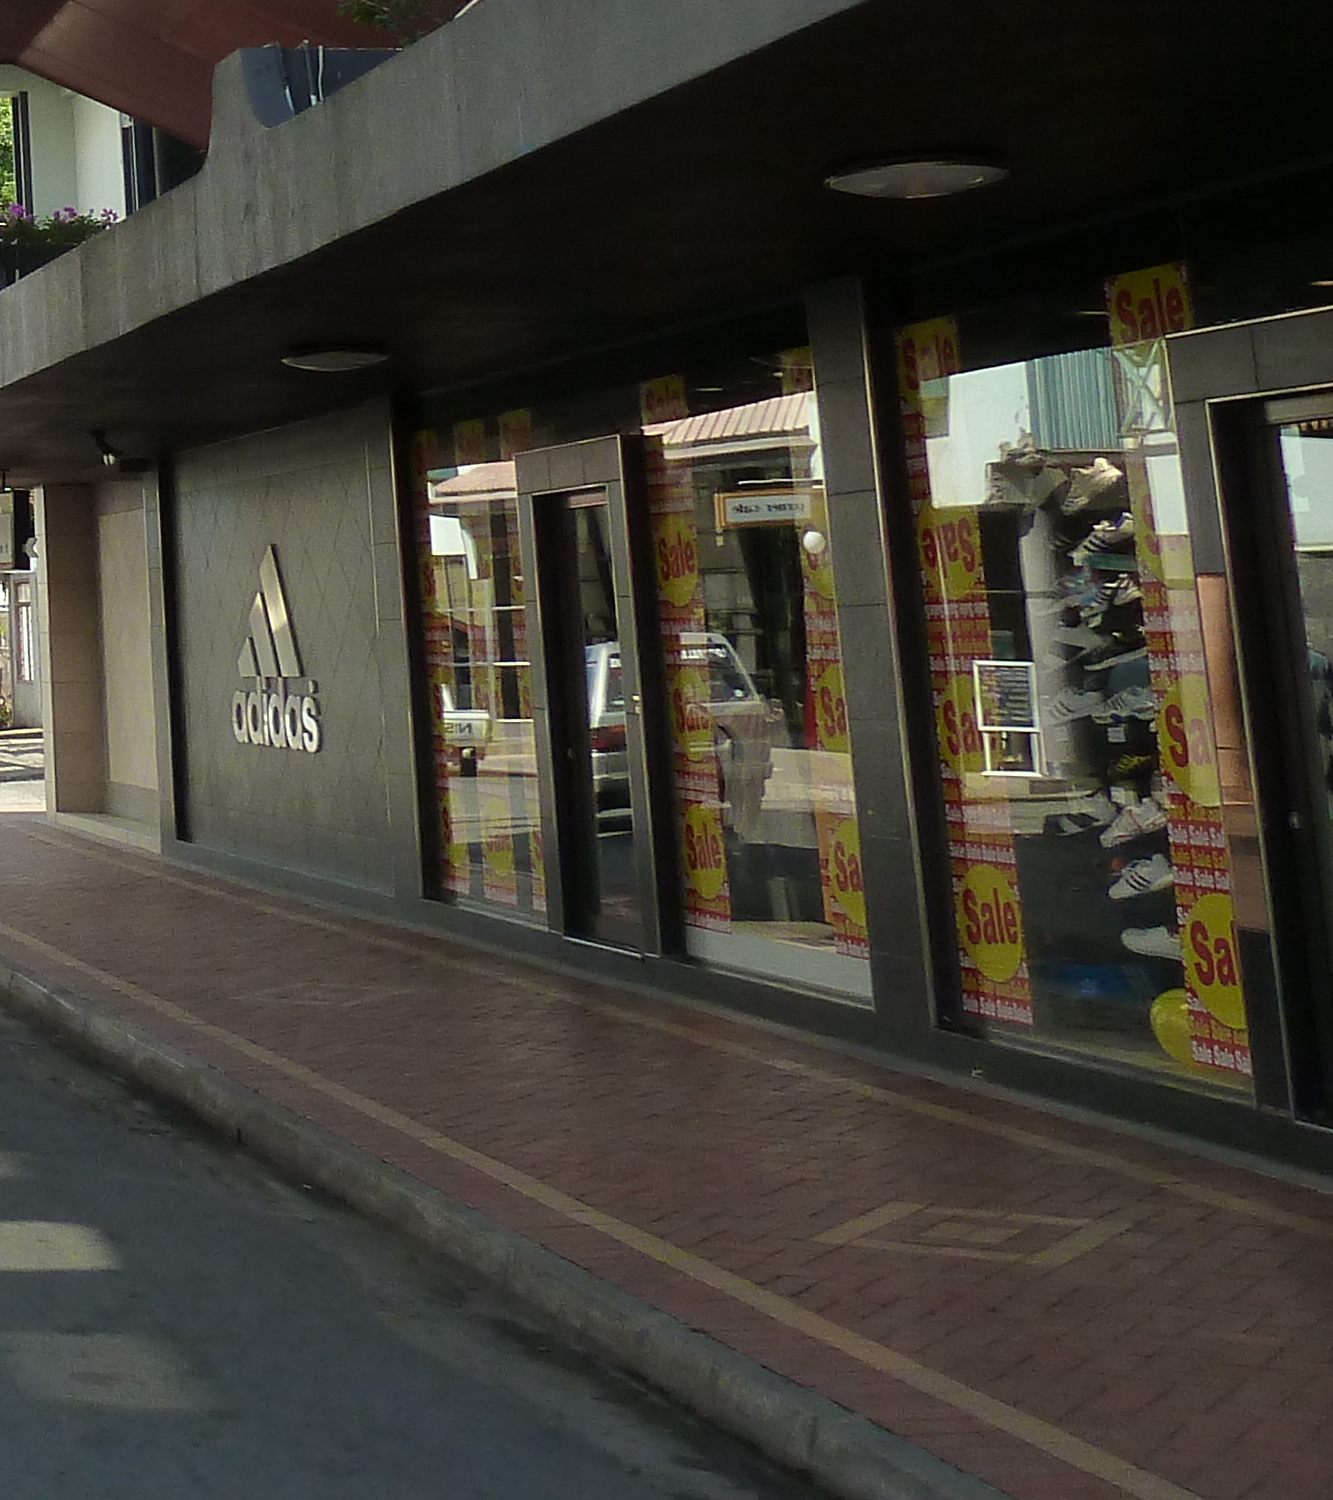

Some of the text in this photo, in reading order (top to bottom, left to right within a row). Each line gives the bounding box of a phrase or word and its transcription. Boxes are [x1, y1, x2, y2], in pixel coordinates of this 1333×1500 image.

[1116, 277, 1185, 344] Sale
[658, 525, 696, 581] Sale
[232, 675, 319, 752] adidas
[820, 686, 848, 737] Sa
[1165, 704, 1215, 767] Sa
[686, 823, 722, 871] Sale
[835, 841, 863, 892] Sa
[962, 887, 1019, 945] Sale
